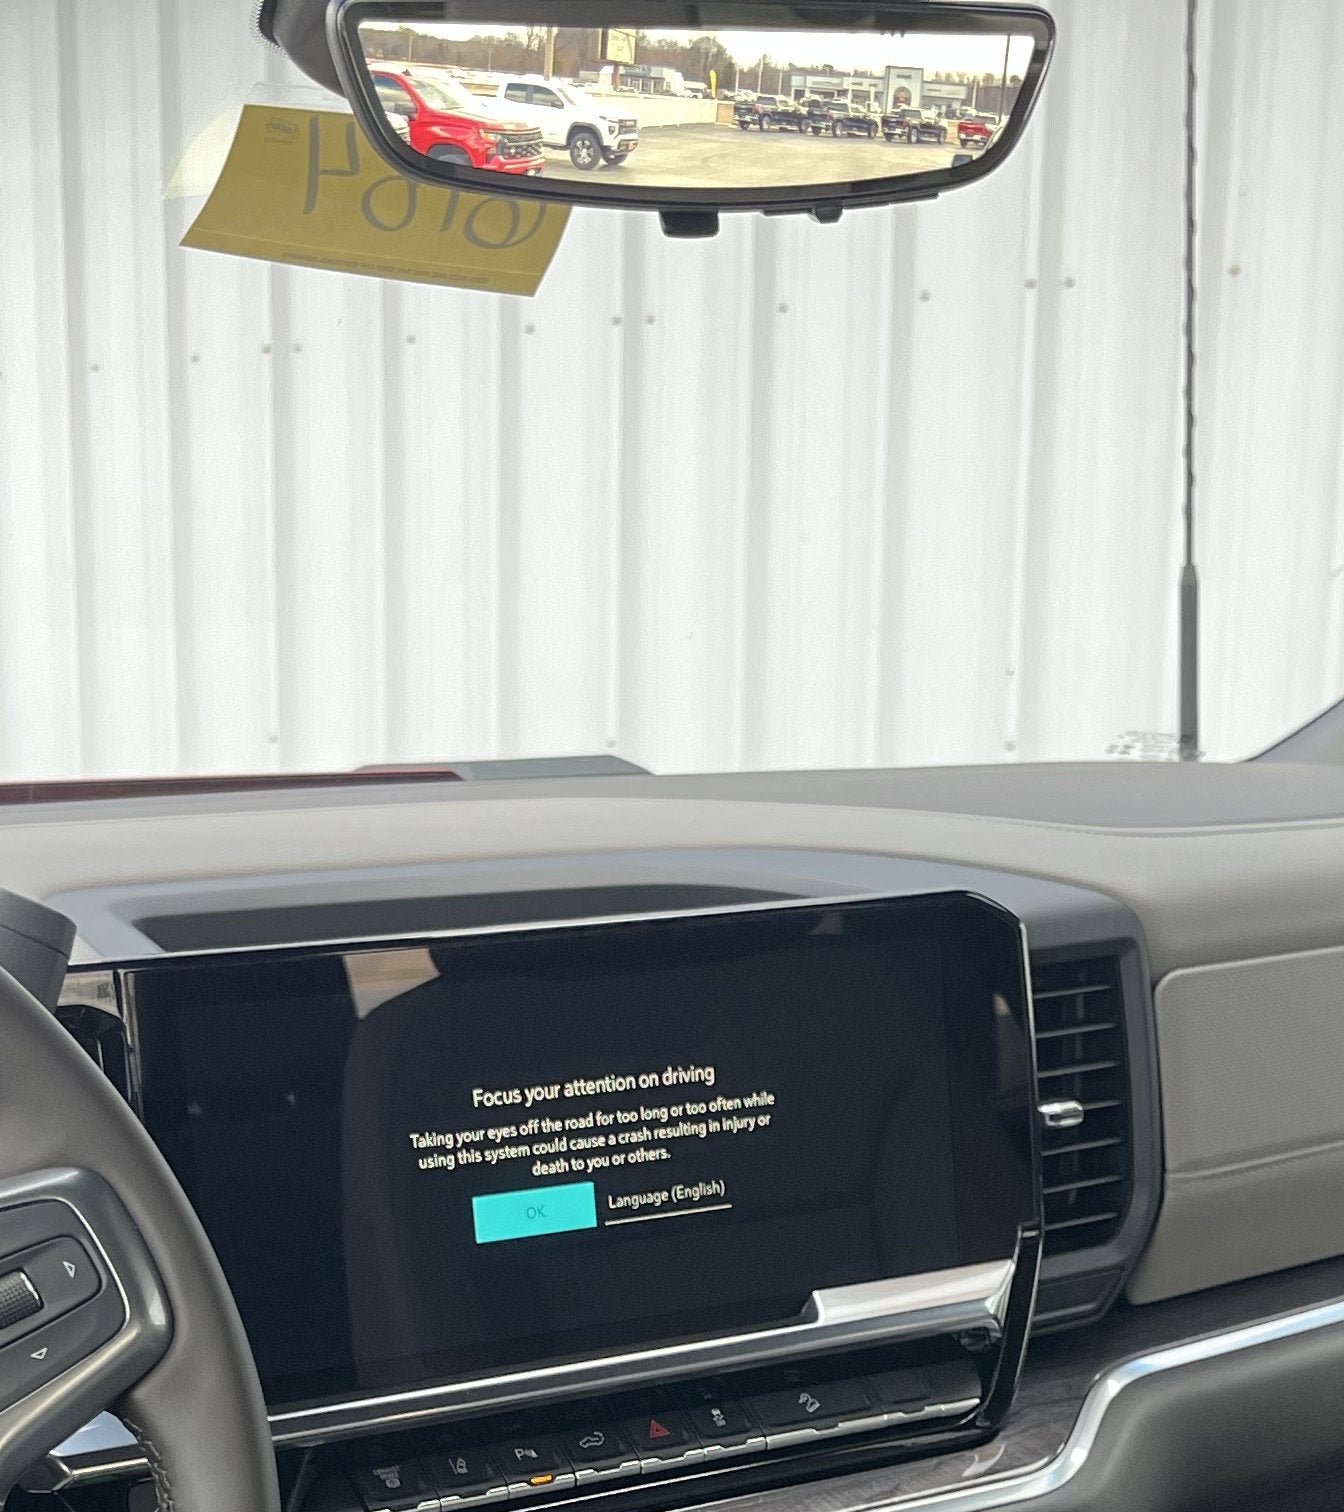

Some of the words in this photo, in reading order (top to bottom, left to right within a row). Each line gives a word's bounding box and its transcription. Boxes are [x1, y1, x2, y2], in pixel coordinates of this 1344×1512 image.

[471, 1087, 522, 1108] Focus
[525, 1084, 560, 1107] your
[563, 1074, 636, 1098] attention
[638, 1072, 659, 1089] on
[661, 1065, 715, 1086] driving
[409, 1132, 454, 1149] Taking
[455, 1129, 485, 1147] your
[487, 1124, 517, 1143] eyes
[519, 1119, 539, 1136] off
[541, 1117, 563, 1134] the
[565, 1112, 594, 1131] road
[595, 1110, 615, 1128] for
[616, 1109, 638, 1124] too
[640, 1106, 668, 1122] long
[670, 1106, 683, 1118] or
[685, 1101, 706, 1115] too
[708, 1096, 742, 1113] often
[743, 1091, 775, 1108] while
[418, 1153, 455, 1170] using
[457, 1149, 483, 1165] this
[484, 1144, 530, 1165] system
[532, 1136, 567, 1155] could
[569, 1134, 605, 1150] cause
[607, 1134, 616, 1146] a
[617, 1126, 652, 1144] crash
[653, 1121, 706, 1139] resulting
[708, 1118, 720, 1133] in
[722, 1116, 755, 1134] injury
[757, 1114, 771, 1127] or
[531, 1156, 569, 1176] death
[571, 1157, 585, 1171] to
[586, 1155, 609, 1173] you
[611, 1153, 626, 1166] or
[627, 1147, 671, 1163] others.
[526, 1205, 546, 1220] OK
[608, 1189, 669, 1209] Language
[671, 1180, 725, 1203] (English)
